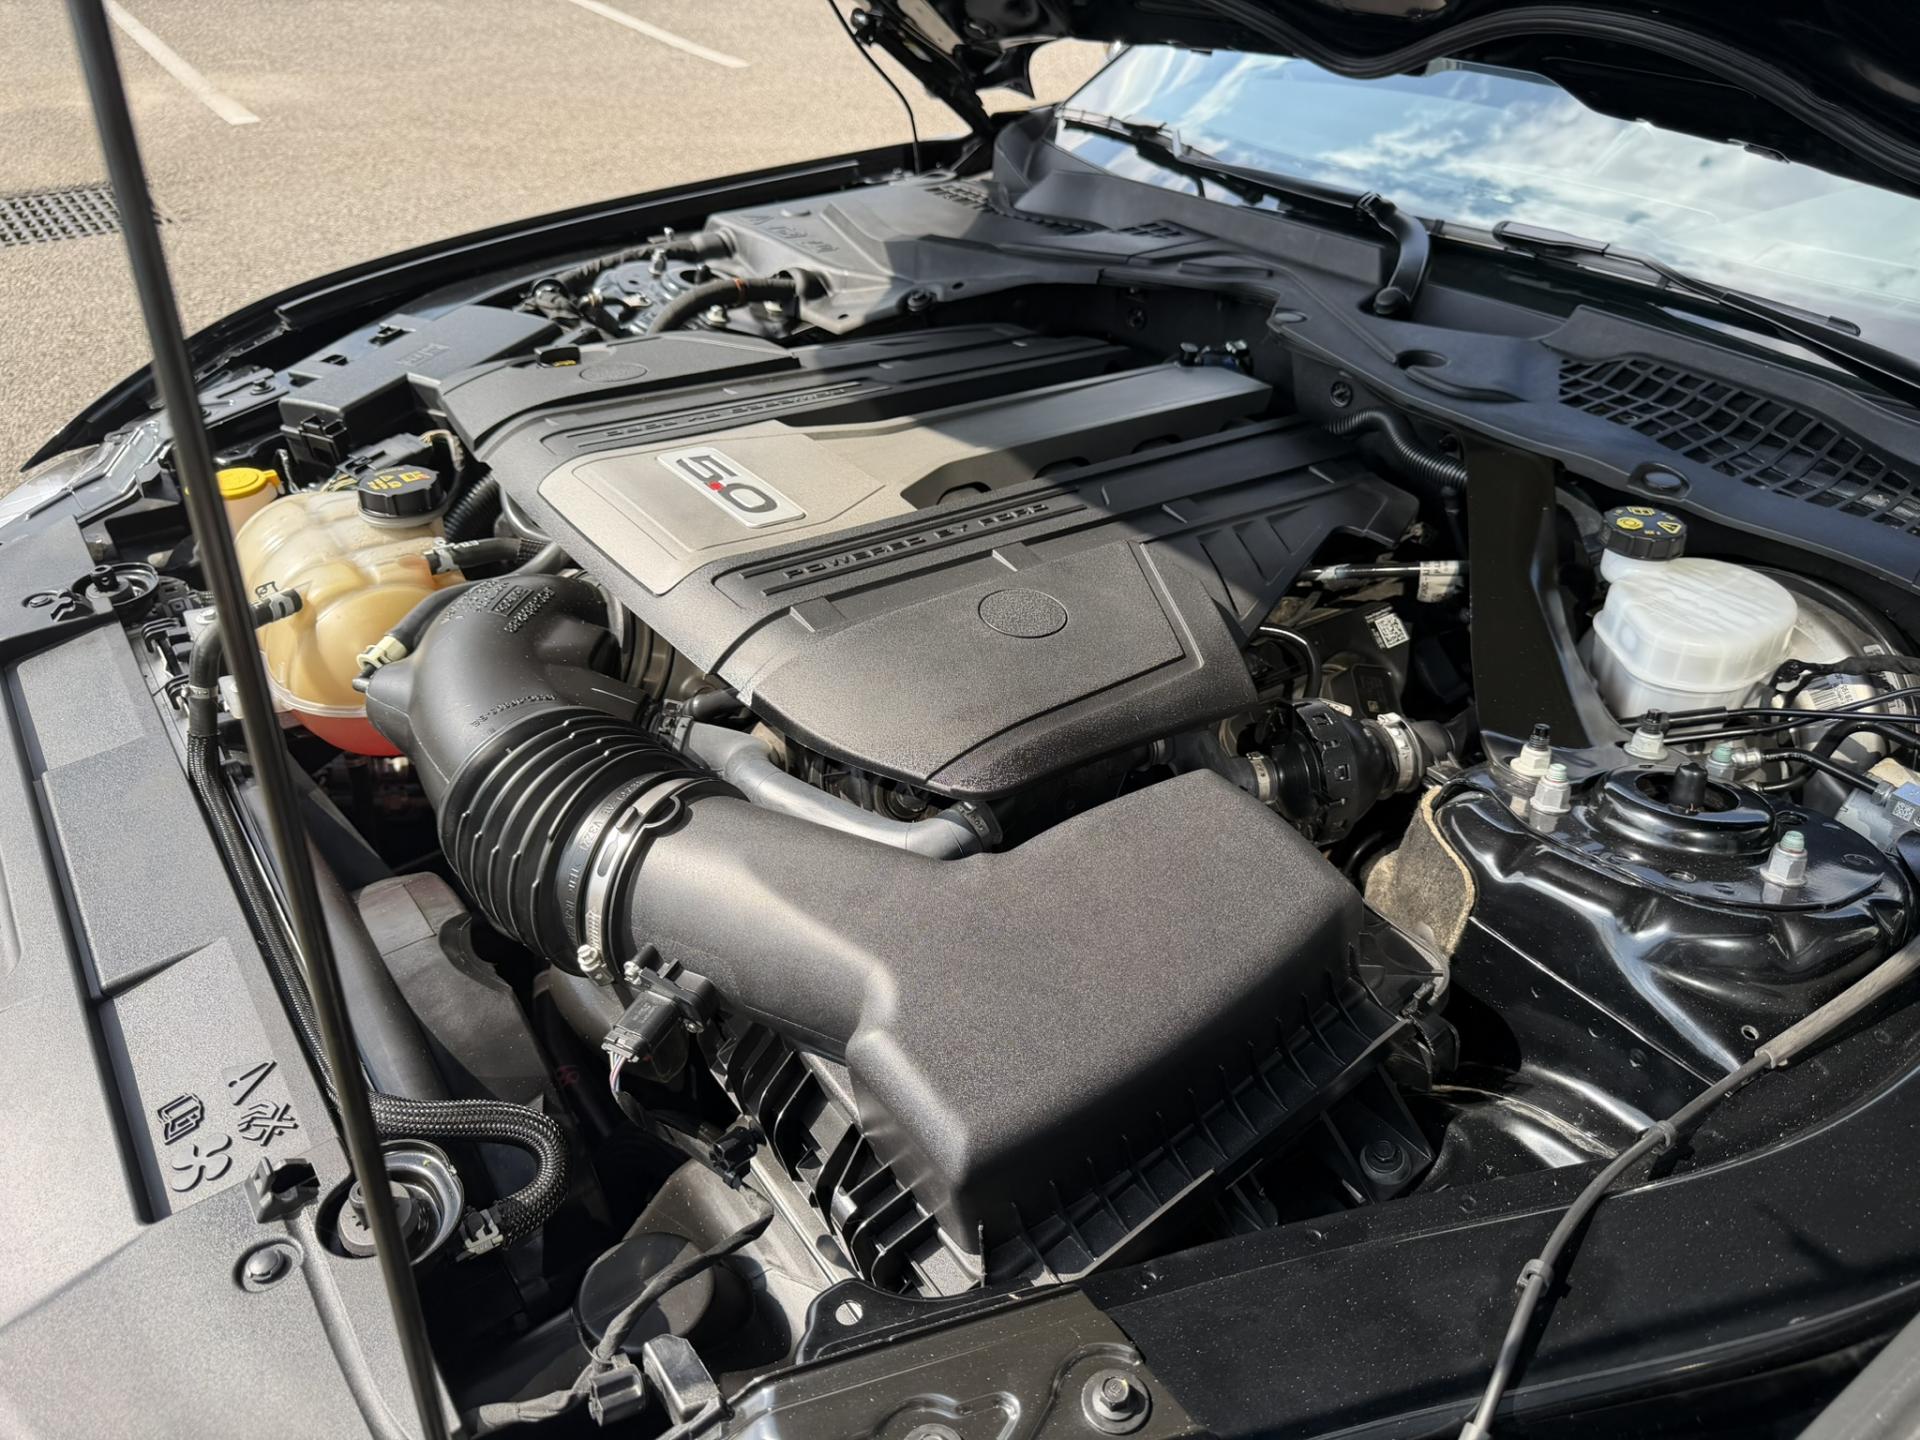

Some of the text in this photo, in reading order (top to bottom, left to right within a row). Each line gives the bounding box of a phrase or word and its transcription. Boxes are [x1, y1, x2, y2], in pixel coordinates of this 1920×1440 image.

[675, 454, 779, 514] 5.0
[783, 503, 1050, 580] POWERED BY FORD
